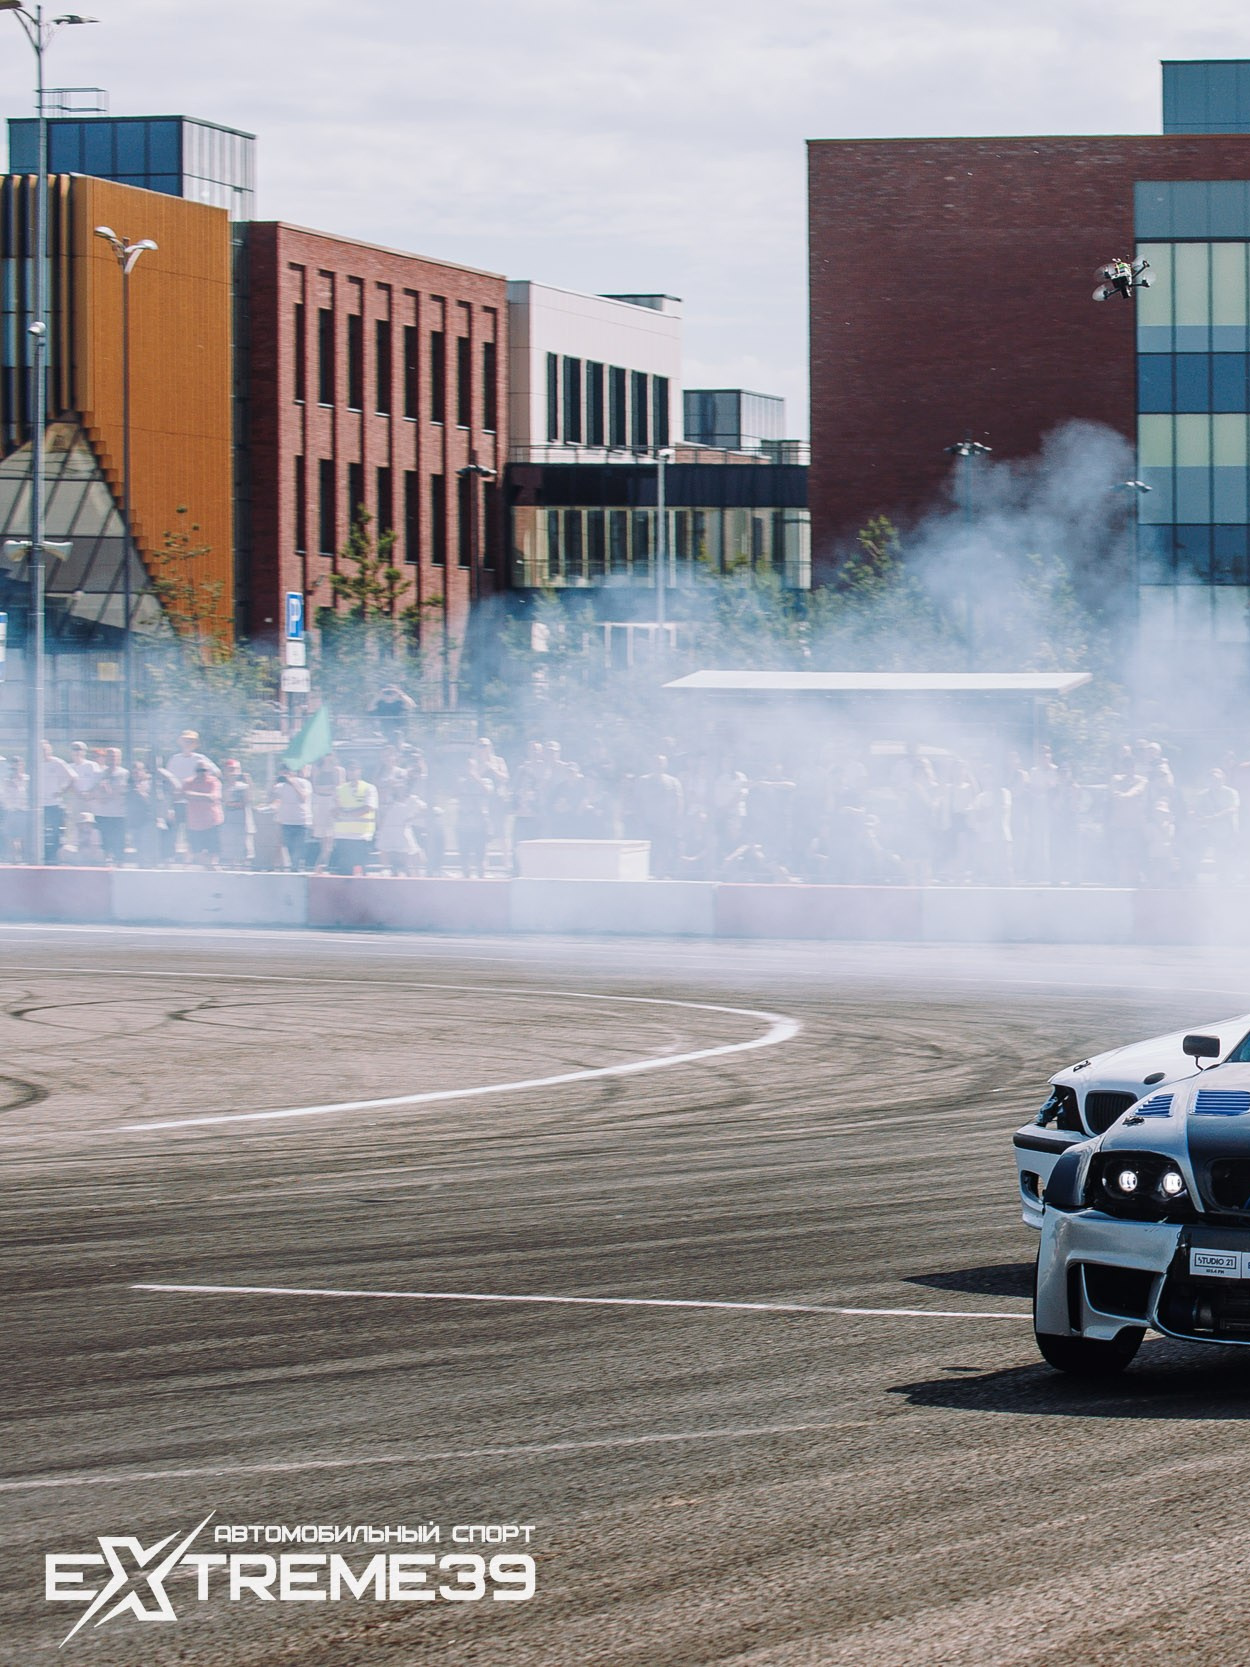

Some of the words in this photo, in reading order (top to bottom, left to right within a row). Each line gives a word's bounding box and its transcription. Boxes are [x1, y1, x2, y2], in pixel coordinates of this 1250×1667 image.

[289, 598, 302, 634] P
[1197, 1256, 1225, 1266] STUDIO
[1226, 1259, 1234, 1267] 21
